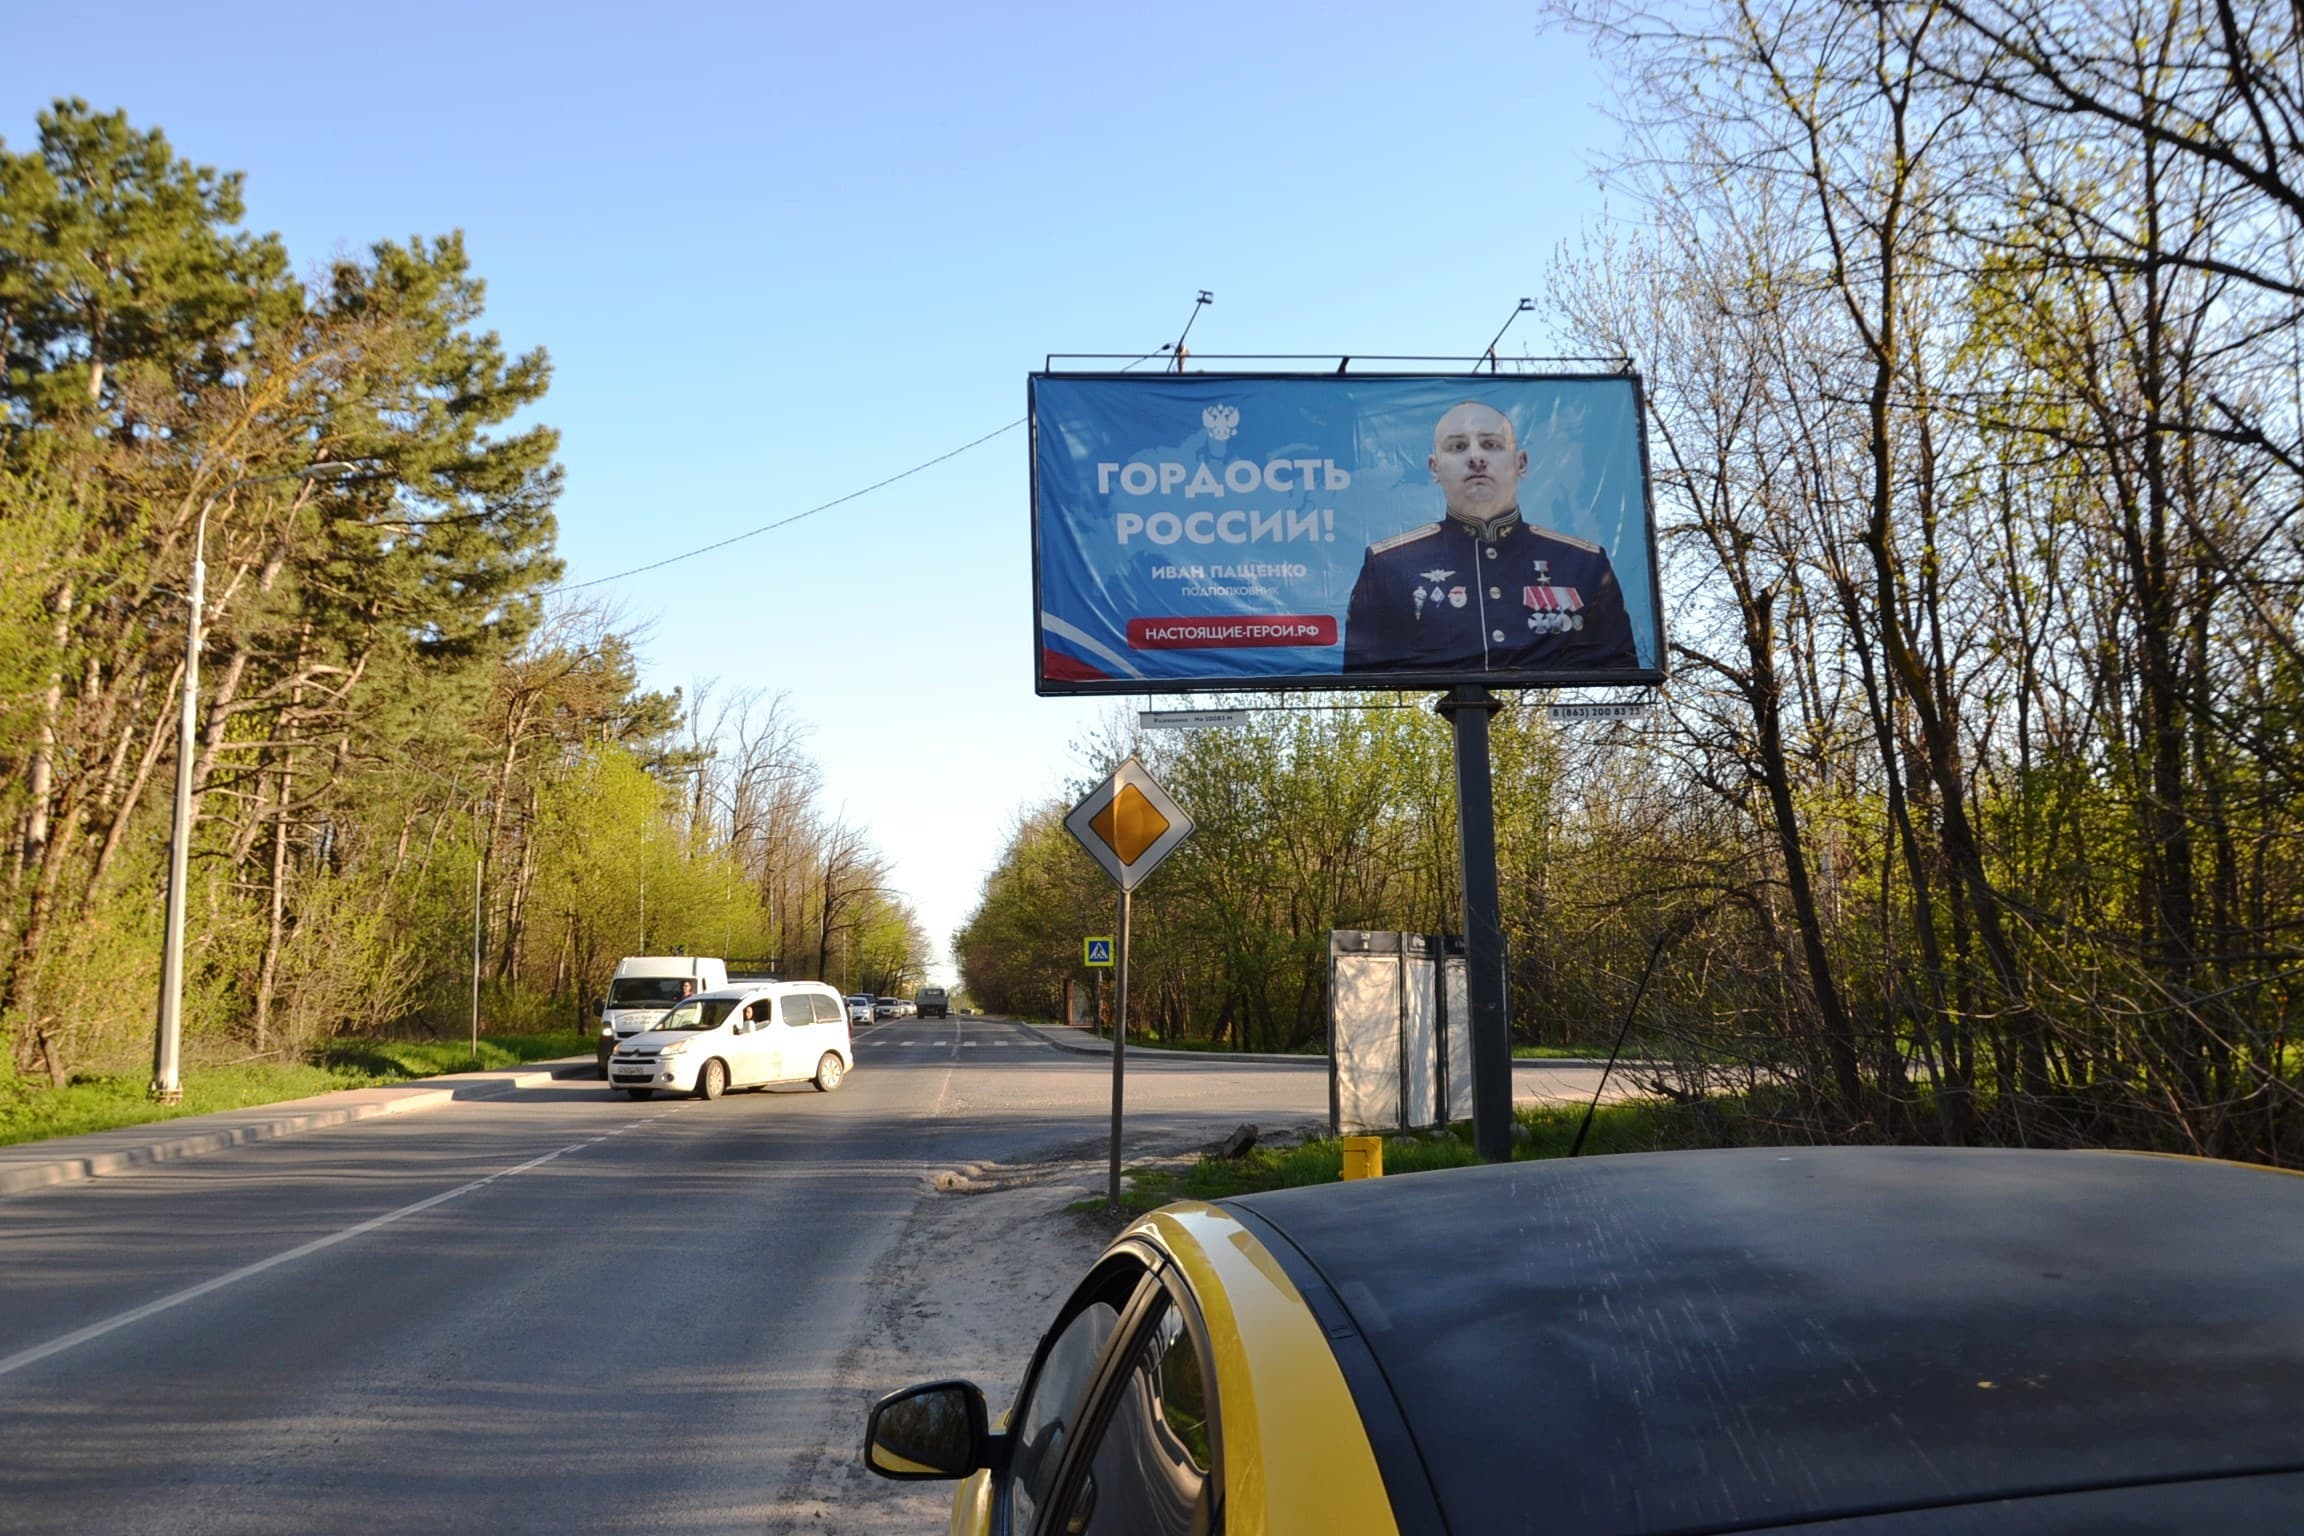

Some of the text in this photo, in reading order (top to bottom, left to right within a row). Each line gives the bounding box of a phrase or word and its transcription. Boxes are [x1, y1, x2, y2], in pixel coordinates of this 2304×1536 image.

[1097, 458, 1350, 498] ГОРДОСТЬ
[1116, 510, 1335, 545] РОССИИ!
[1151, 563, 1307, 580] ИВАН ПАЩЕНКО
[1182, 585, 1279, 597] ПОДПОЛКОВНИК
[1145, 624, 1319, 640] НАСТОЯЩИЕ-ГЕРОИ.РФ
[1592, 707, 1611, 717] 200
